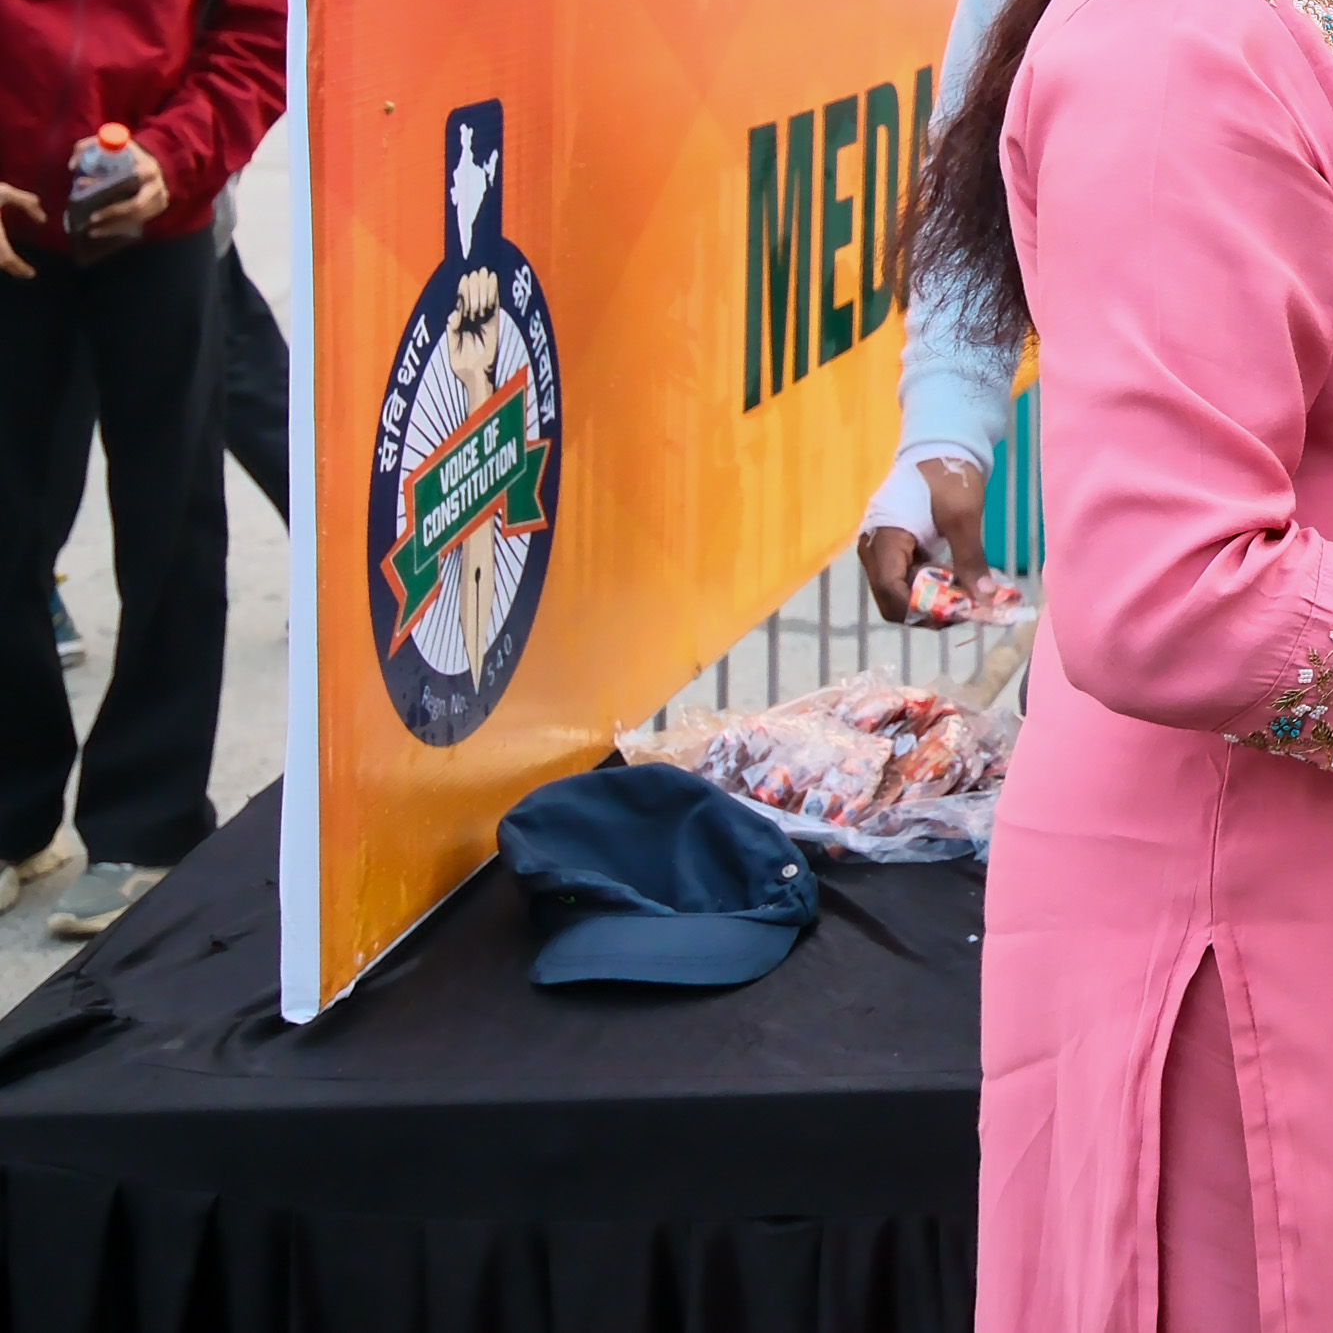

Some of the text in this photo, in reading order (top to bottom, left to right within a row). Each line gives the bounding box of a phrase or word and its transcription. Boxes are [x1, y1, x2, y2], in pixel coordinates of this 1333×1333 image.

[743, 64, 934, 414] MED
[511, 264, 532, 317] की
[422, 436, 518, 548] CONSTITUTION
[440, 417, 500, 495] VOICE OF
